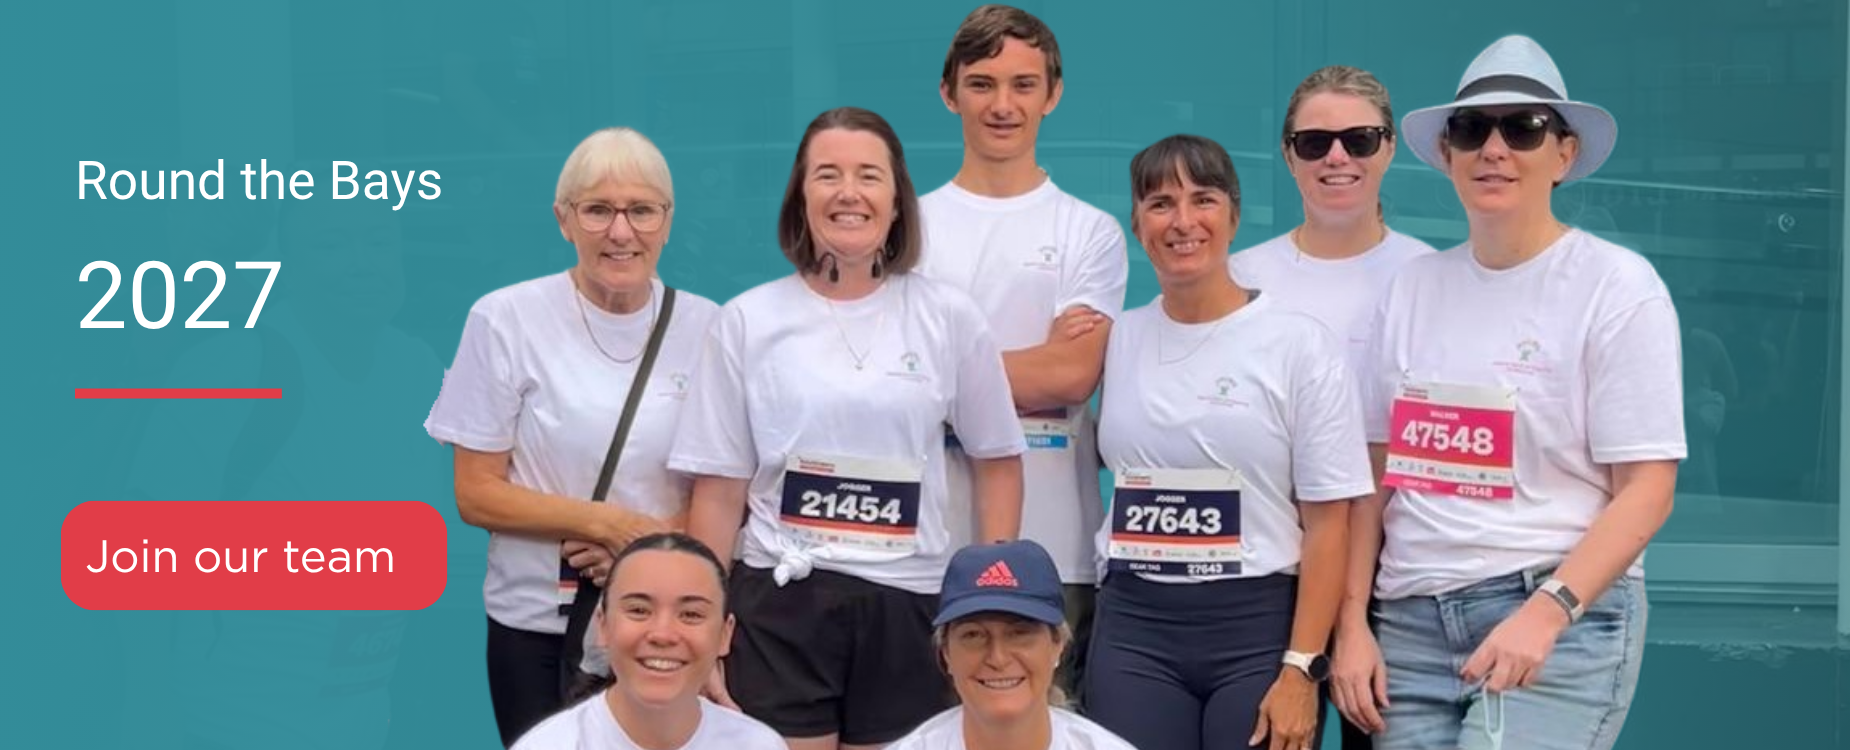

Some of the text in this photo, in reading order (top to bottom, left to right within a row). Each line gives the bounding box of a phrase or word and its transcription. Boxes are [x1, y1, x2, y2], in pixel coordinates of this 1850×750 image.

[1401, 420, 1495, 456] 47548
[836, 482, 873, 493] JOGGER
[1456, 485, 1494, 498] 47548
[1155, 494, 1187, 504] JOGGER
[799, 489, 902, 525] 21454
[1125, 504, 1223, 535] 27643
[1186, 563, 1224, 575] 27643
[975, 576, 1018, 587] adidas
